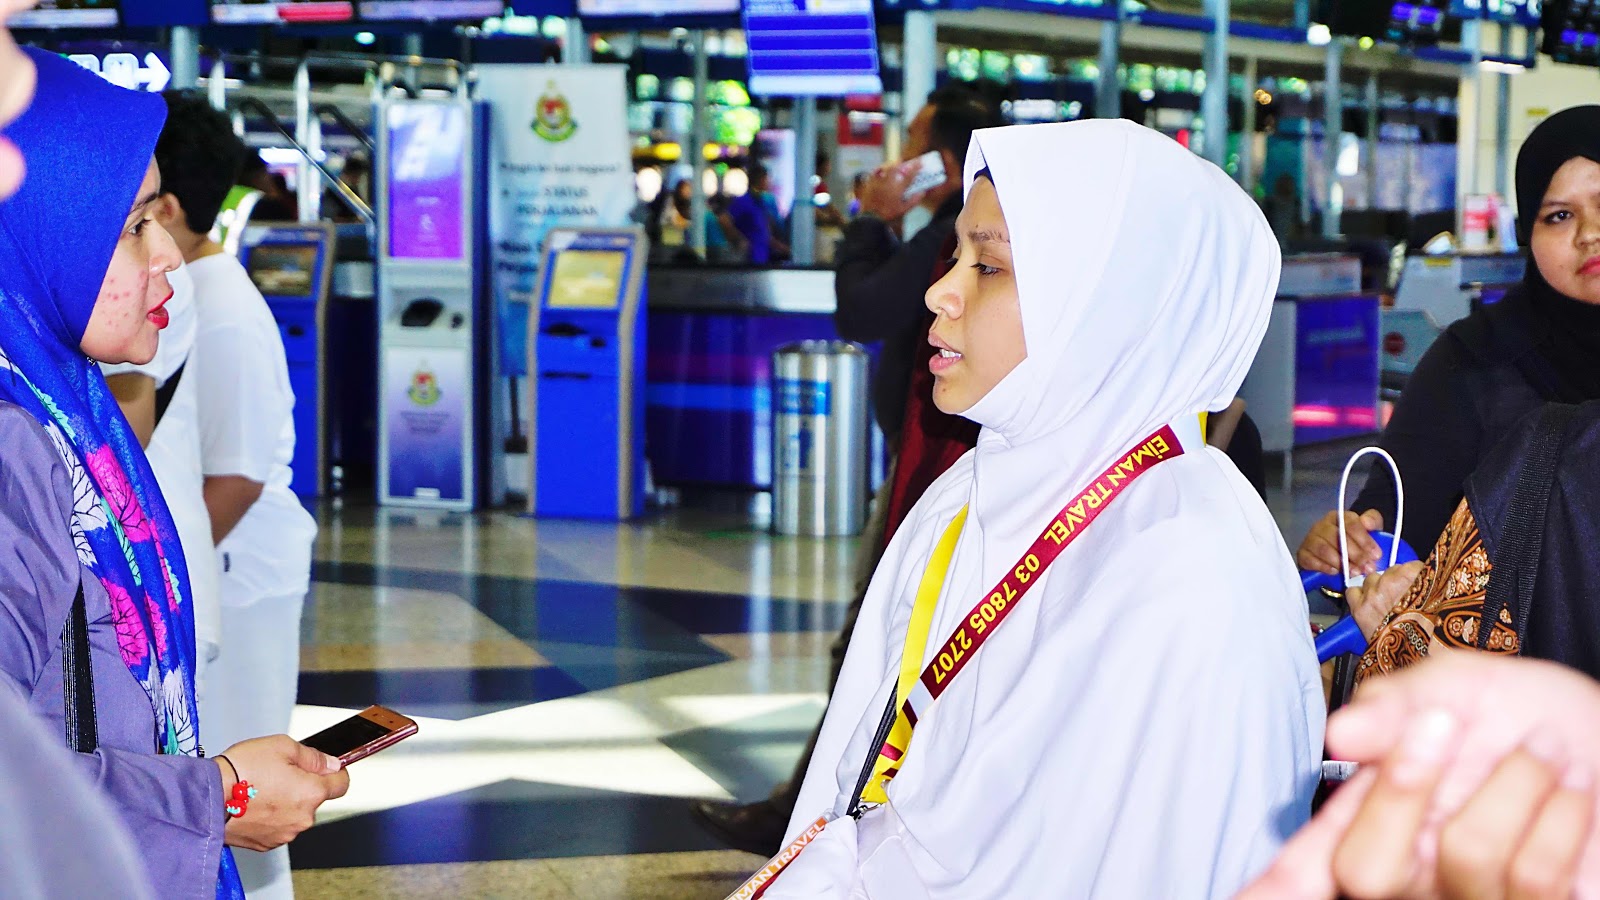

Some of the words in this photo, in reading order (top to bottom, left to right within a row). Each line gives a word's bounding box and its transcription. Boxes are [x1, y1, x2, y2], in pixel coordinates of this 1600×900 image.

[1043, 481, 1113, 545] TRAVEL
[1014, 553, 1040, 584] 03
[969, 581, 1018, 635] 7805
[931, 628, 973, 685] 2707
[770, 823, 825, 869] TRAVEL
